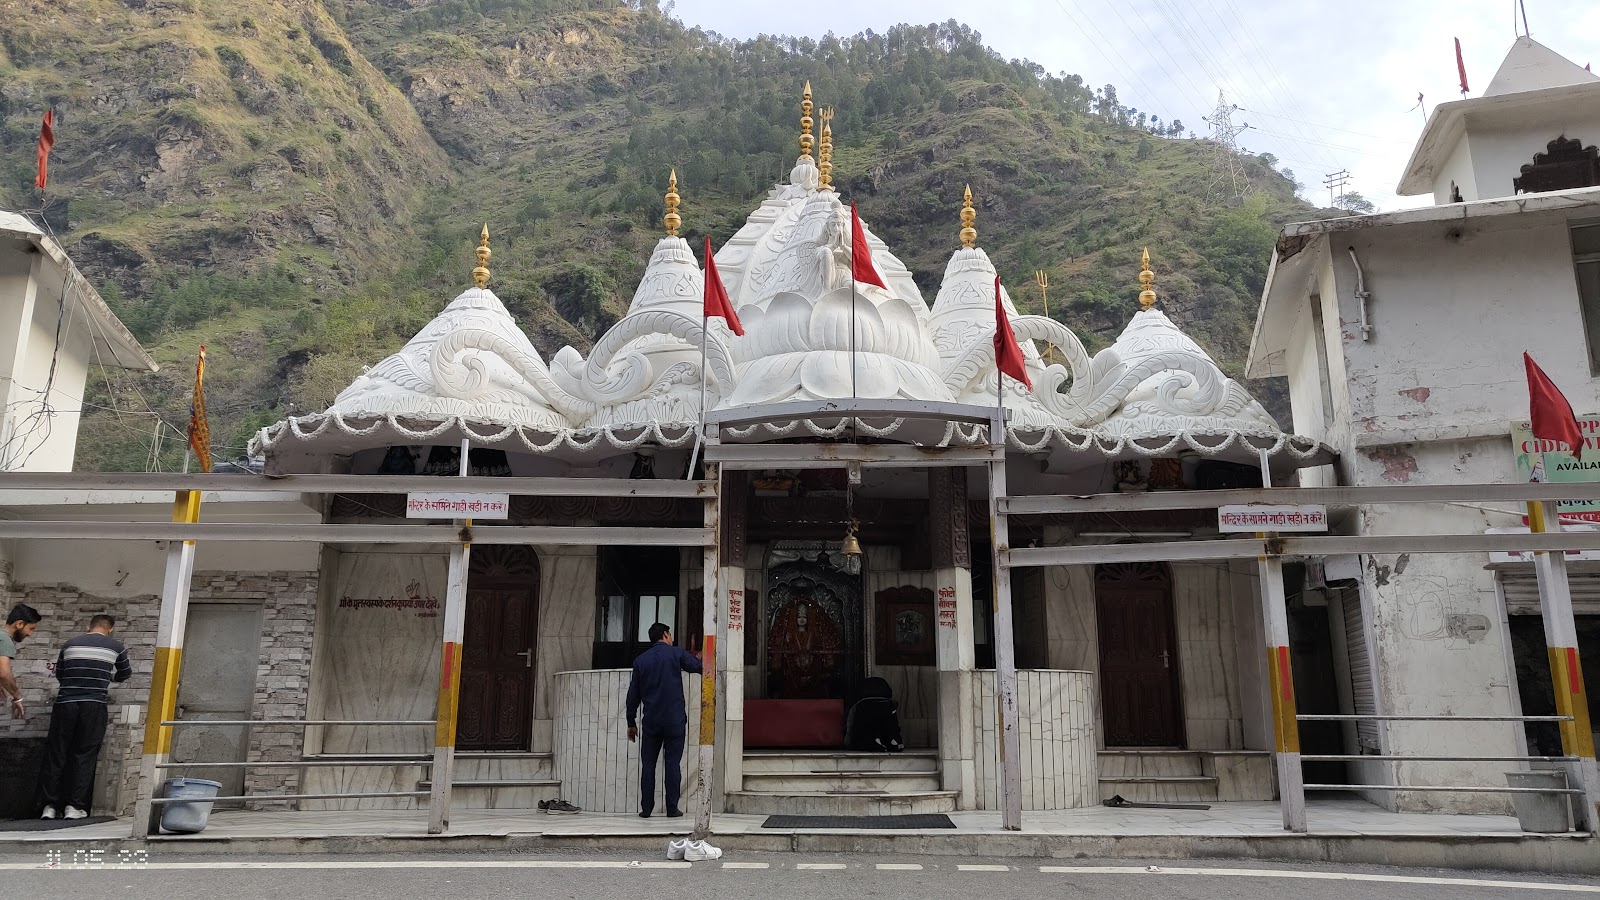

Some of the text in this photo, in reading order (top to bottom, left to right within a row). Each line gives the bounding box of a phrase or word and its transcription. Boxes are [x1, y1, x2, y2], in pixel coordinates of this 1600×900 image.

[1521, 438, 1570, 453] CIDE
[1556, 461, 1600, 472] AVAILA
[483, 502, 489, 511] न
[1242, 512, 1249, 525] के
[1249, 511, 1269, 525] सामने
[1303, 514, 1309, 524] न
